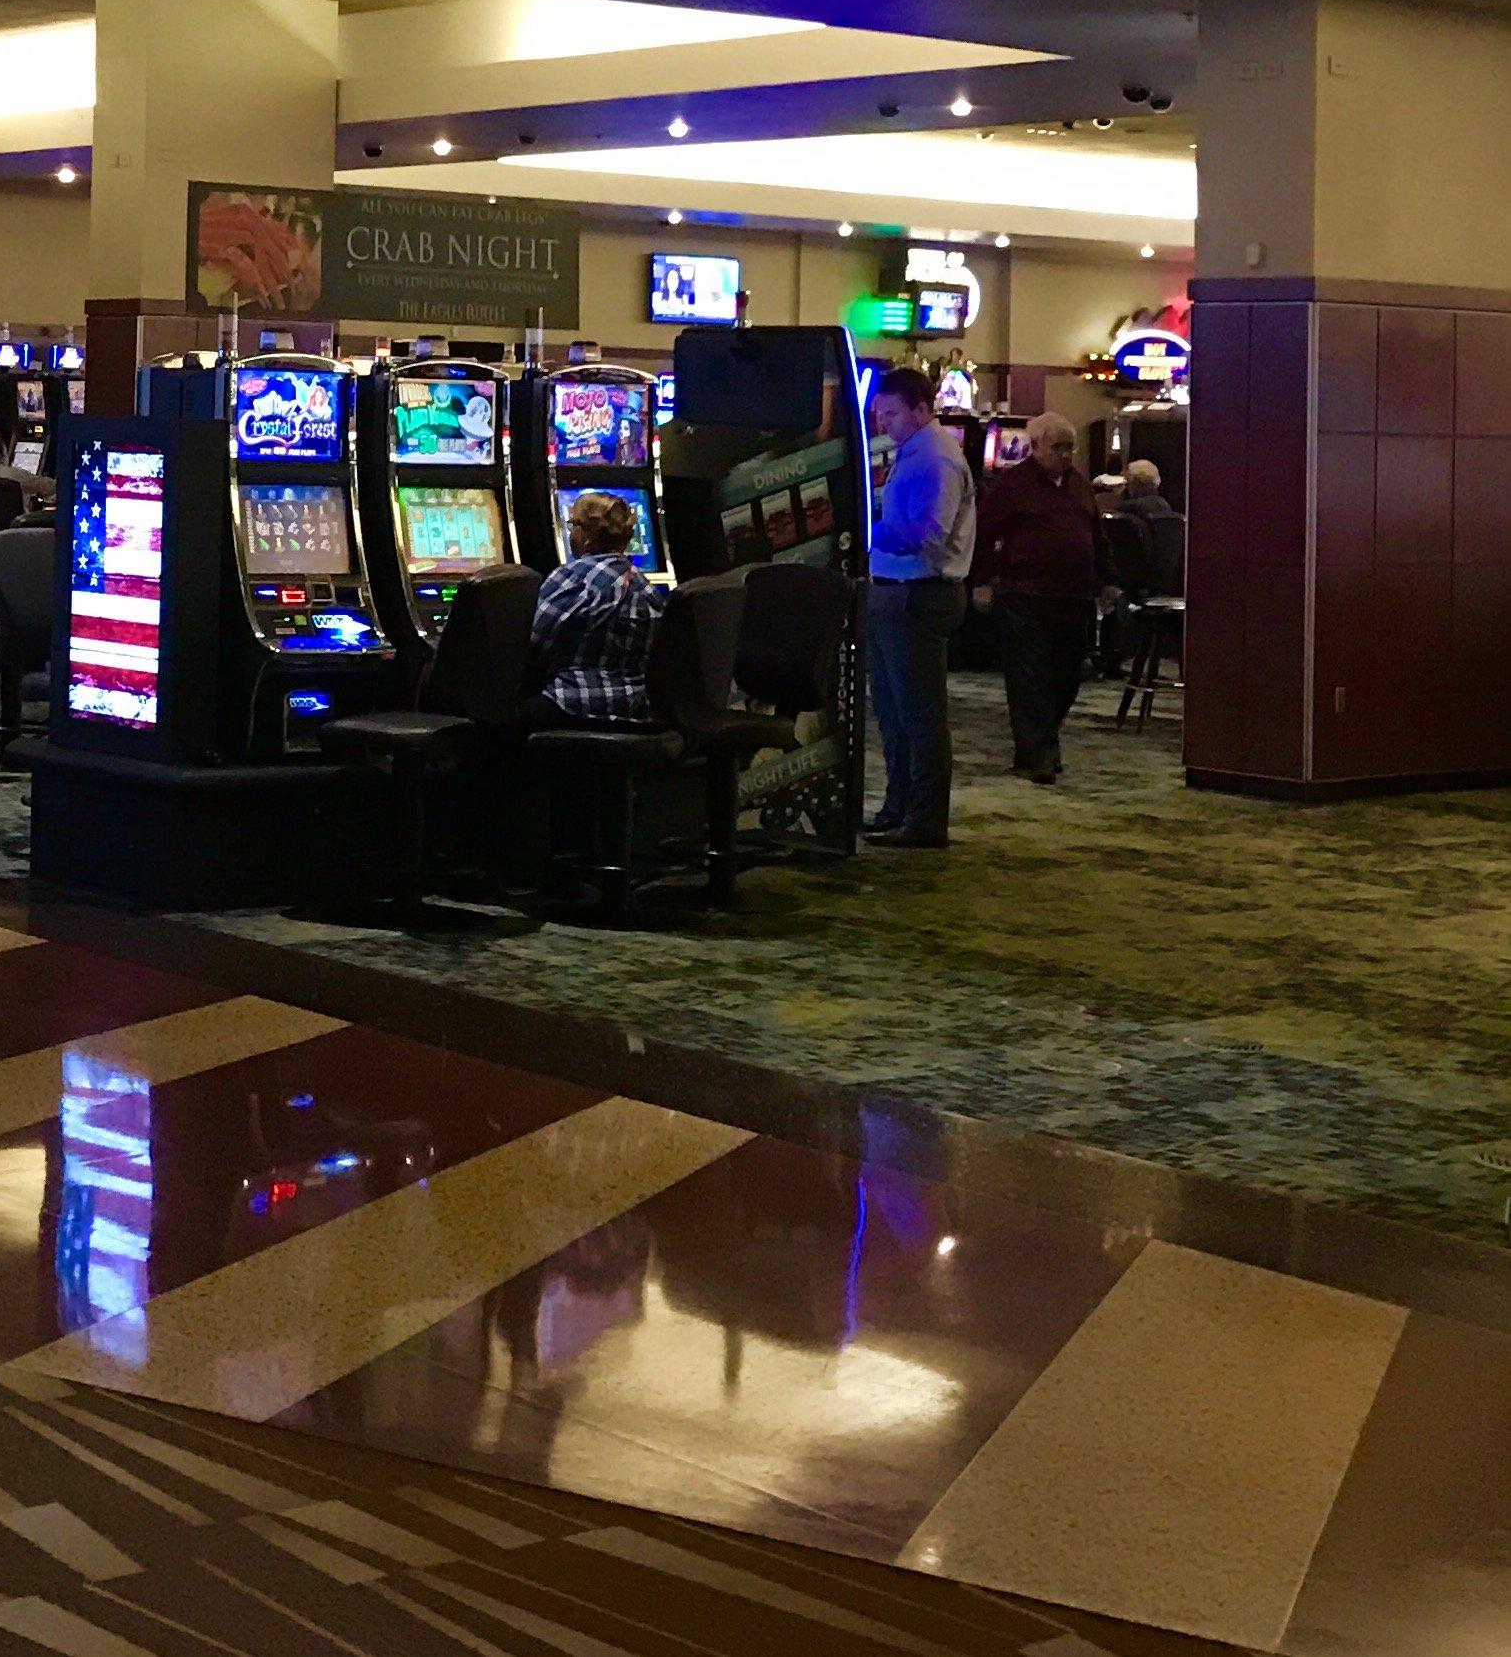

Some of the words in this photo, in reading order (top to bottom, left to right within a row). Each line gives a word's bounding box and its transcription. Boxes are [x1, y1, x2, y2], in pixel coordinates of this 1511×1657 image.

[361, 200, 381, 215] ALL
[387, 202, 416, 217] YOU
[419, 204, 446, 218] CAN
[451, 205, 473, 220] EAT
[347, 225, 434, 264] CRAB
[447, 234, 560, 272] NIGHT
[399, 300, 419, 319] THE
[753, 459, 808, 489] DINING
[788, 749, 820, 775] LIFE
